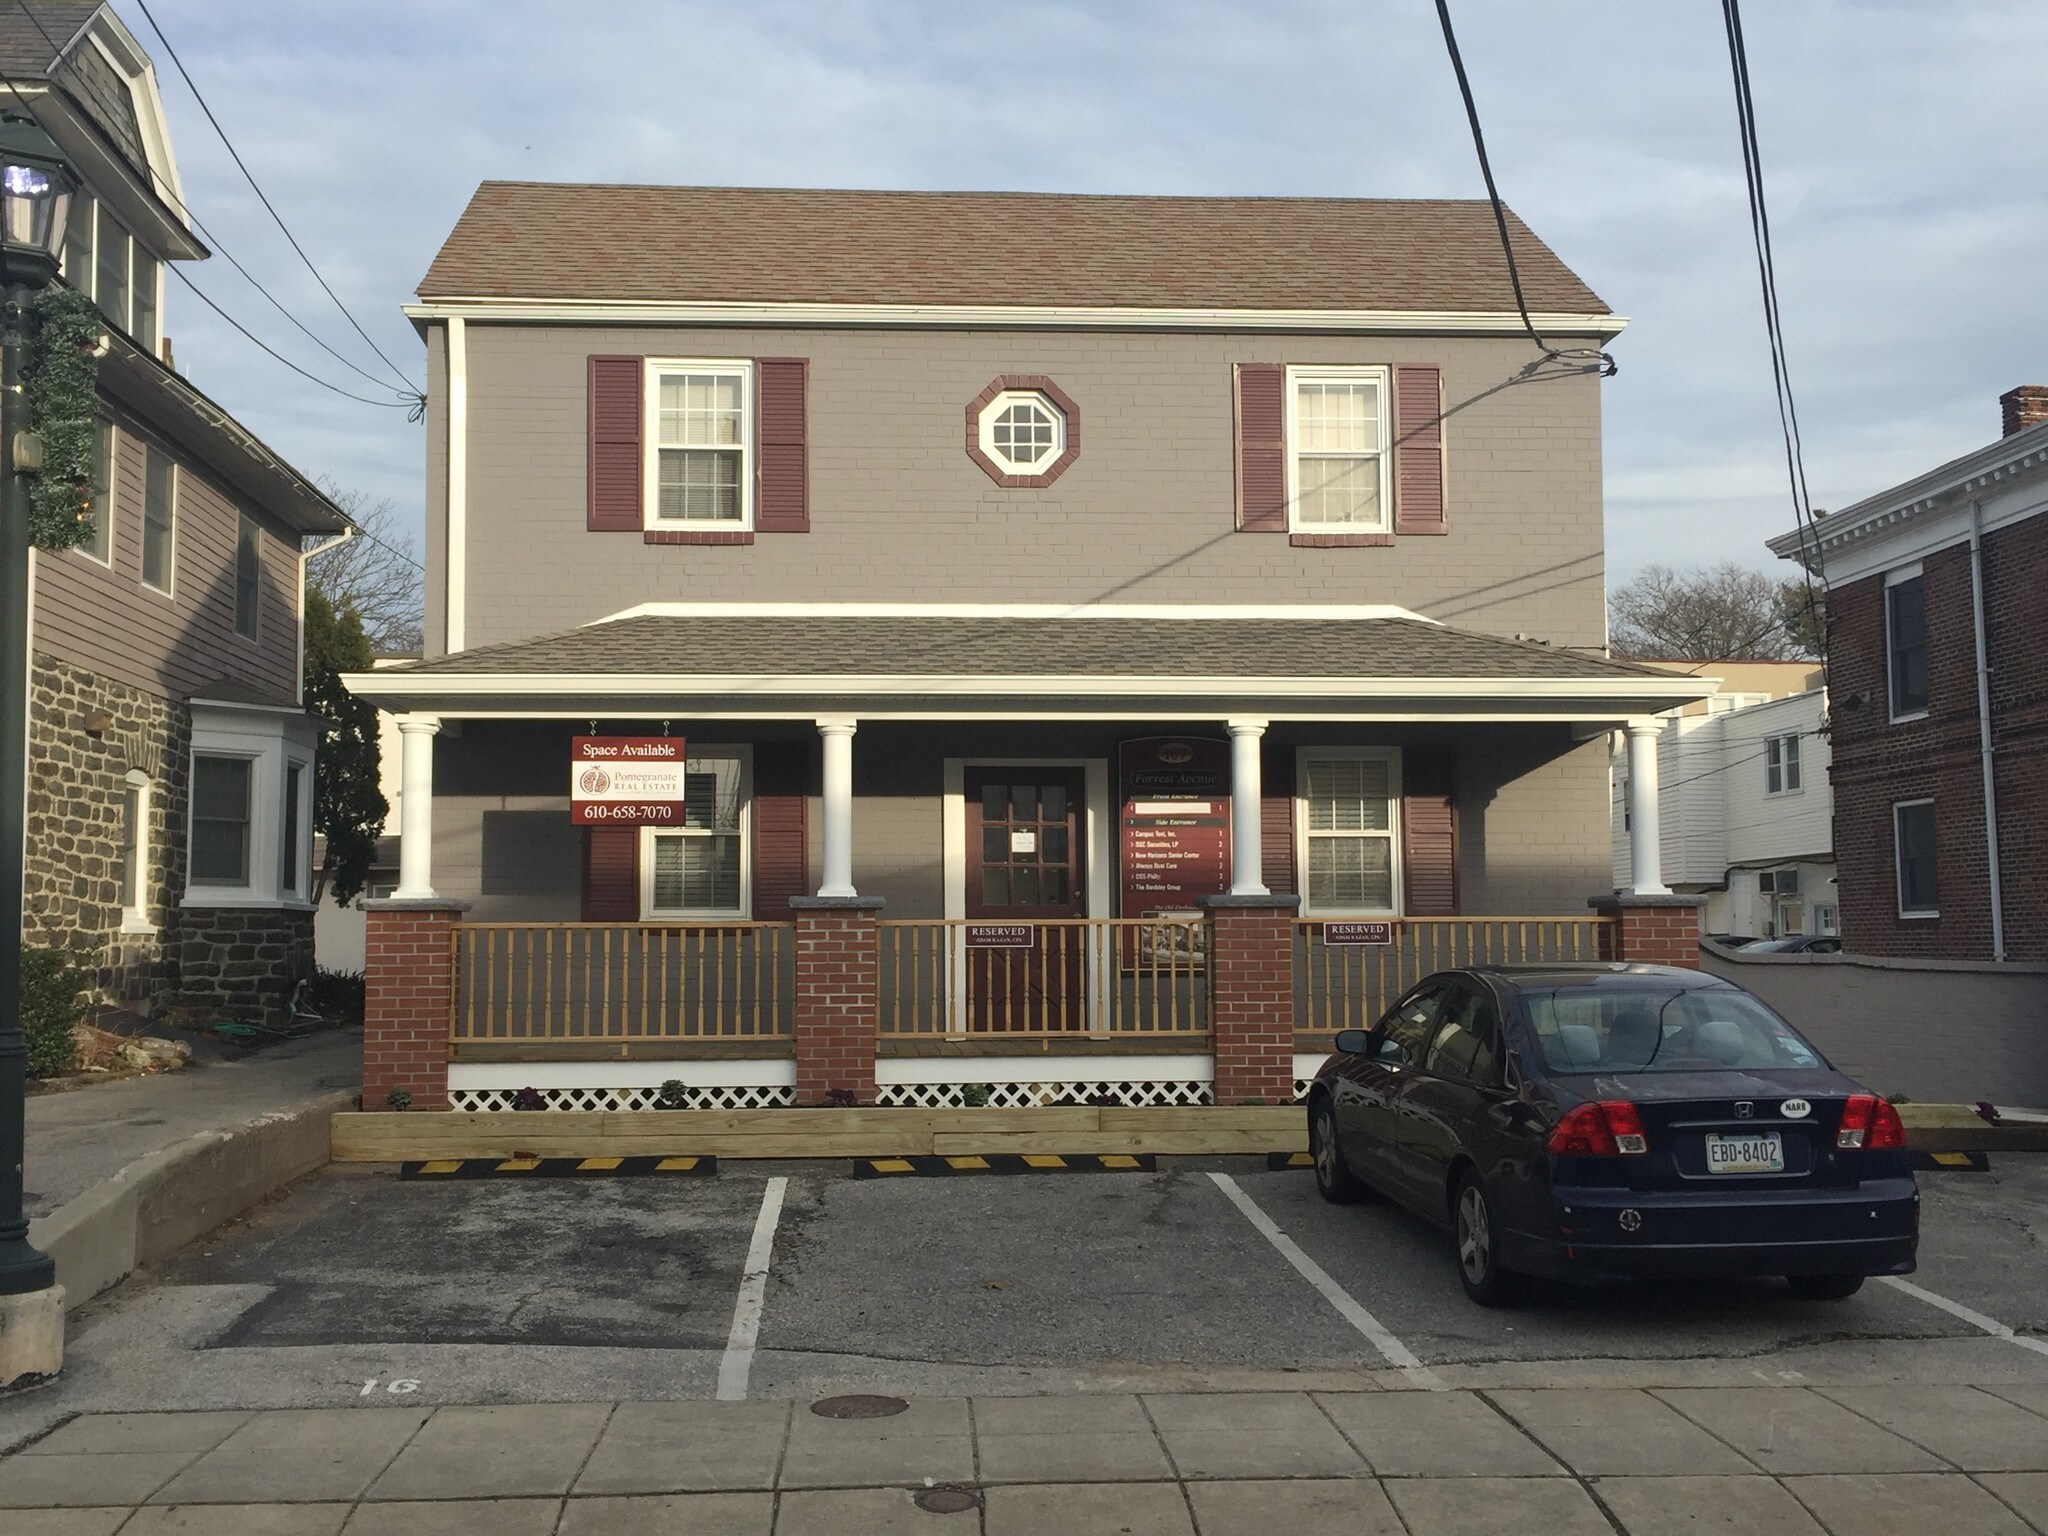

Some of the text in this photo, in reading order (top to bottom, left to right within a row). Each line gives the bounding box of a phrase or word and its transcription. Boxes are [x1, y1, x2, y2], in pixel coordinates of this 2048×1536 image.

[583, 743, 676, 758] Space Available
[615, 772, 677, 783] Pomegranate
[1135, 773, 1218, 784] Forrest Avenue
[614, 783, 677, 791] REAL ESTATE
[584, 805, 672, 819] 610-658-7070
[972, 927, 1026, 935] RESERVED
[1332, 925, 1384, 933] RESERVED
[1785, 1102, 1806, 1111] NARB
[360, 1379, 421, 1396] 16
